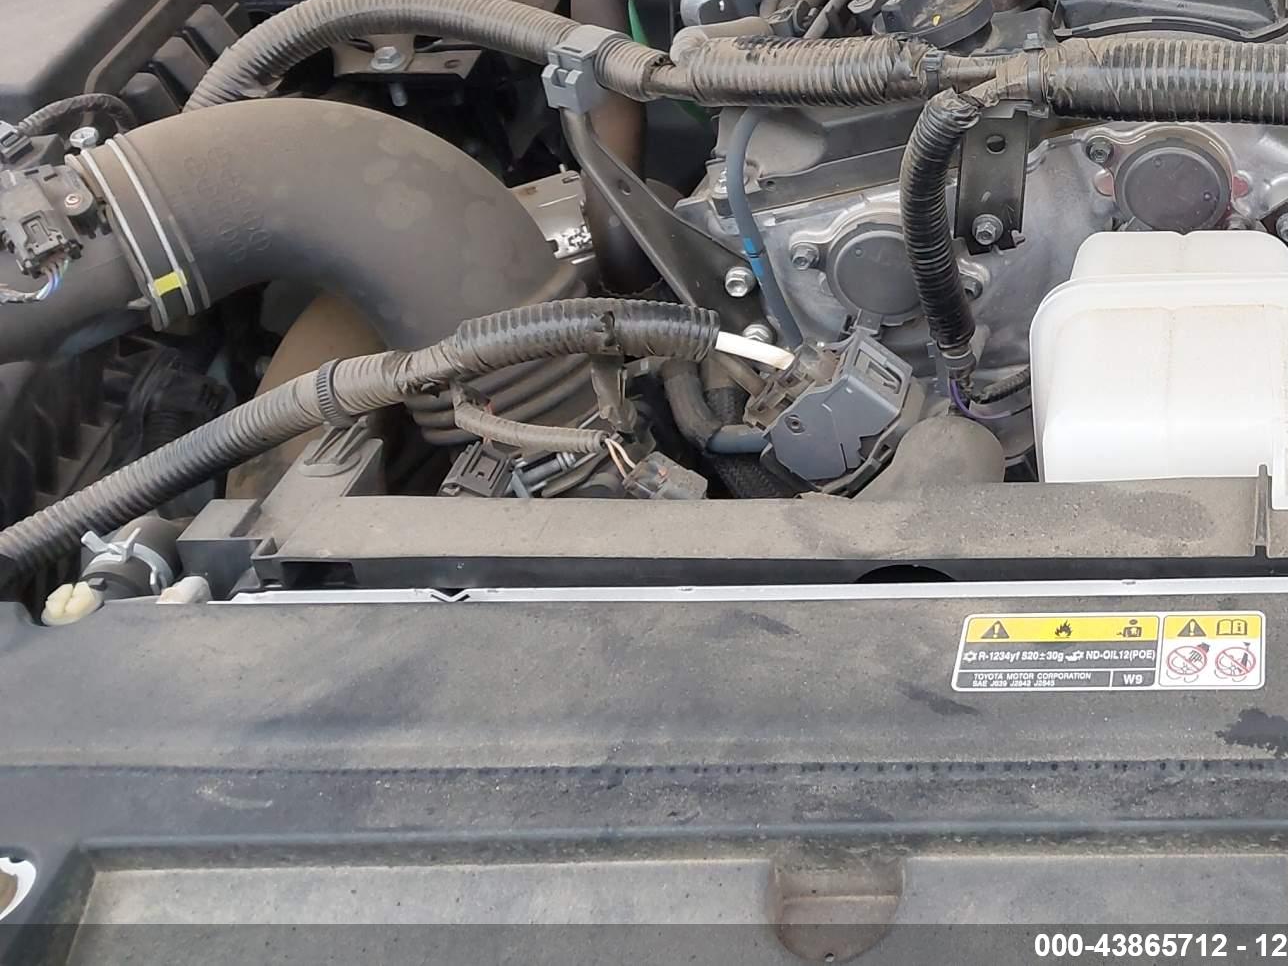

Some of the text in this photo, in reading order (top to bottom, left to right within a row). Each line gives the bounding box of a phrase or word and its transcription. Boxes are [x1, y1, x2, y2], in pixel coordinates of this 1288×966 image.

[977, 650, 1020, 662] R-1234yf
[1085, 649, 1156, 662] ND-OIL12(POE)
[973, 673, 1003, 681] TOYOTA
[1037, 672, 1092, 680] CORPORATION
[1123, 674, 1143, 685] W9
